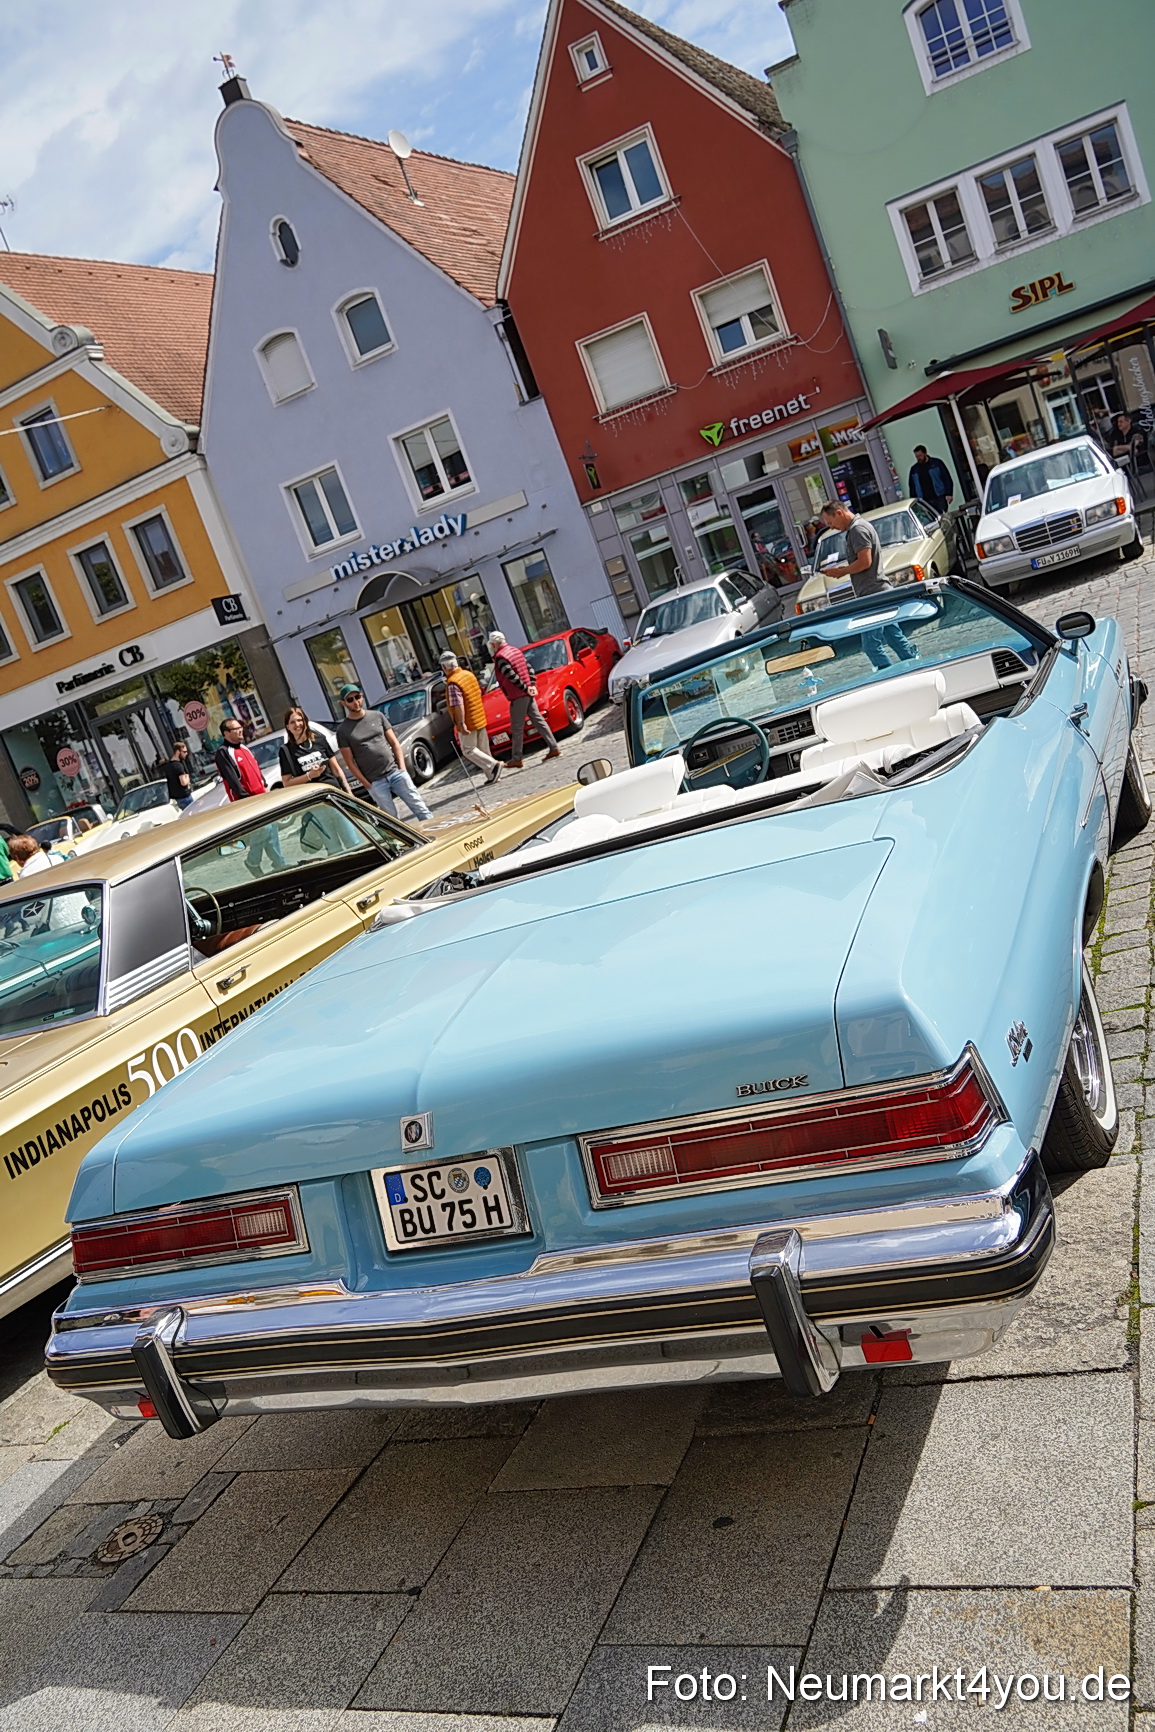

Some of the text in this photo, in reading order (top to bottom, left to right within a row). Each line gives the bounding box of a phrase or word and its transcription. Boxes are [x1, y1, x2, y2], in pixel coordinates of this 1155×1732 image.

[1010, 271, 1076, 313] SIPL
[730, 394, 811, 436] freenet
[329, 512, 467, 581] mister lady
[221, 597, 238, 613] CB
[55, 644, 145, 694] Parfümerie CB
[186, 707, 205, 722] 30%
[59, 754, 77, 768] 30%
[3, 1082, 132, 1180] INDIANAPOLIS
[126, 1027, 201, 1108] 500
[736, 1074, 810, 1098] BUICK
[410, 1170, 446, 1203] SC
[399, 1194, 504, 1238] BU 75 H
